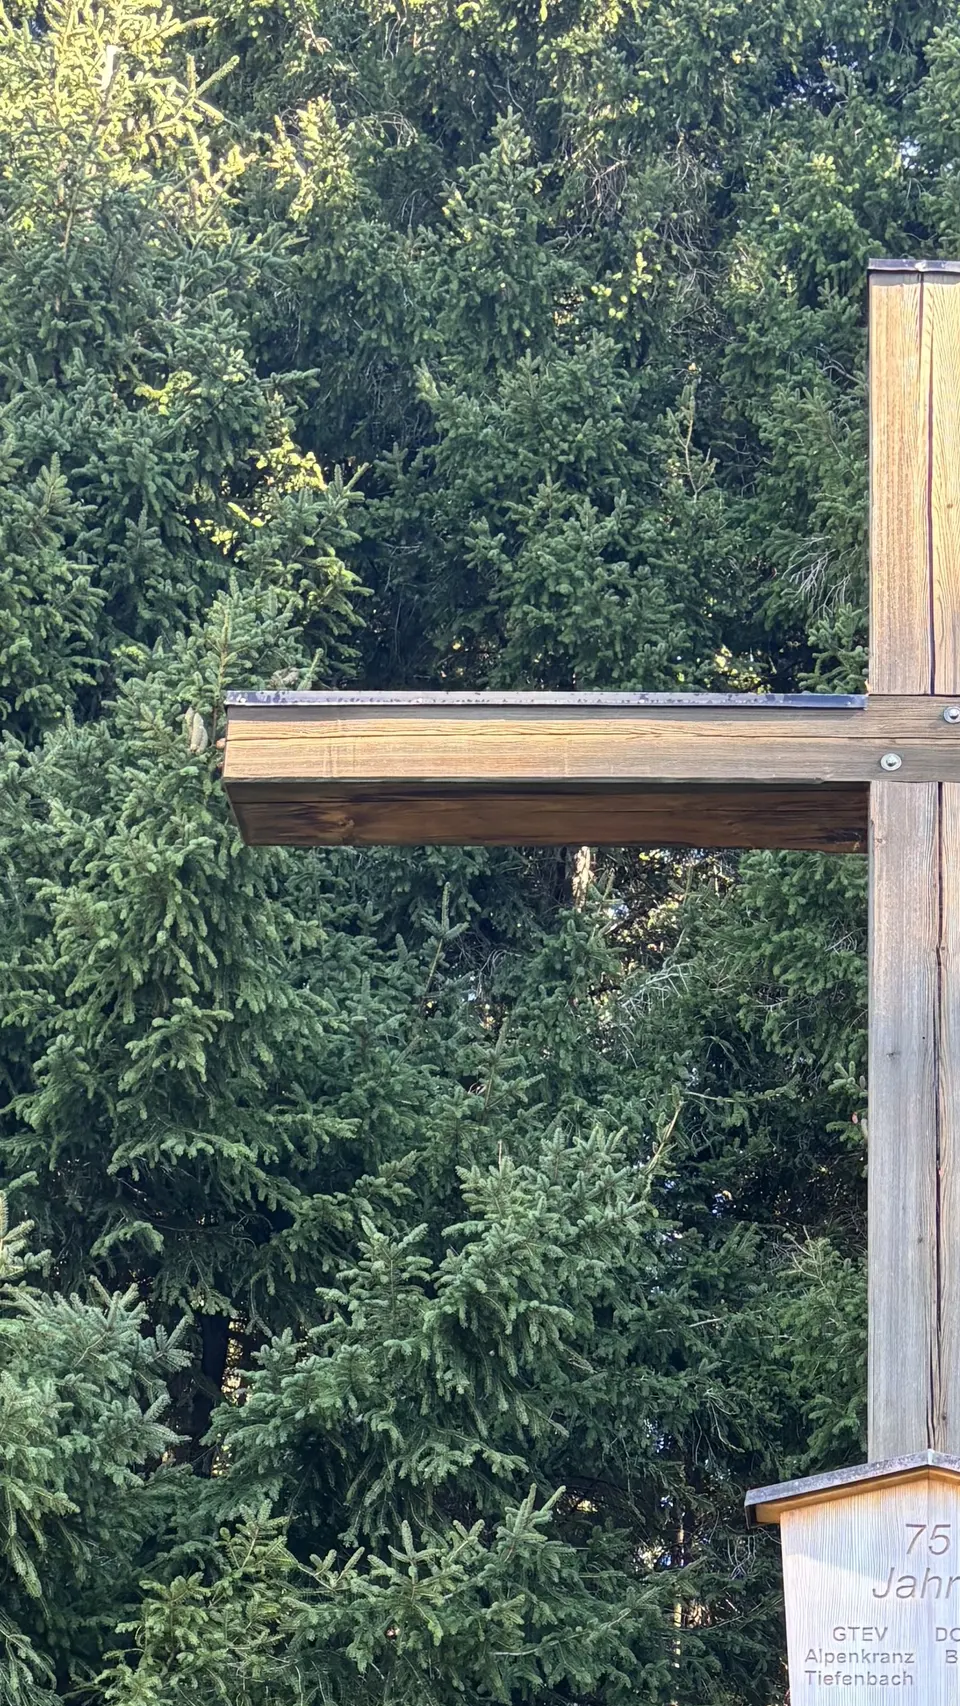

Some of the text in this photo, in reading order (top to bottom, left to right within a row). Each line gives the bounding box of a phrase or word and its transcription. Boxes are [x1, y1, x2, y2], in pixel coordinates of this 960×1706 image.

[905, 1523, 952, 1556] 75
[832, 1626, 889, 1642] GTEV
[804, 1648, 915, 1667] Alpenkranz
[804, 1670, 914, 1686] Tiefenbach
